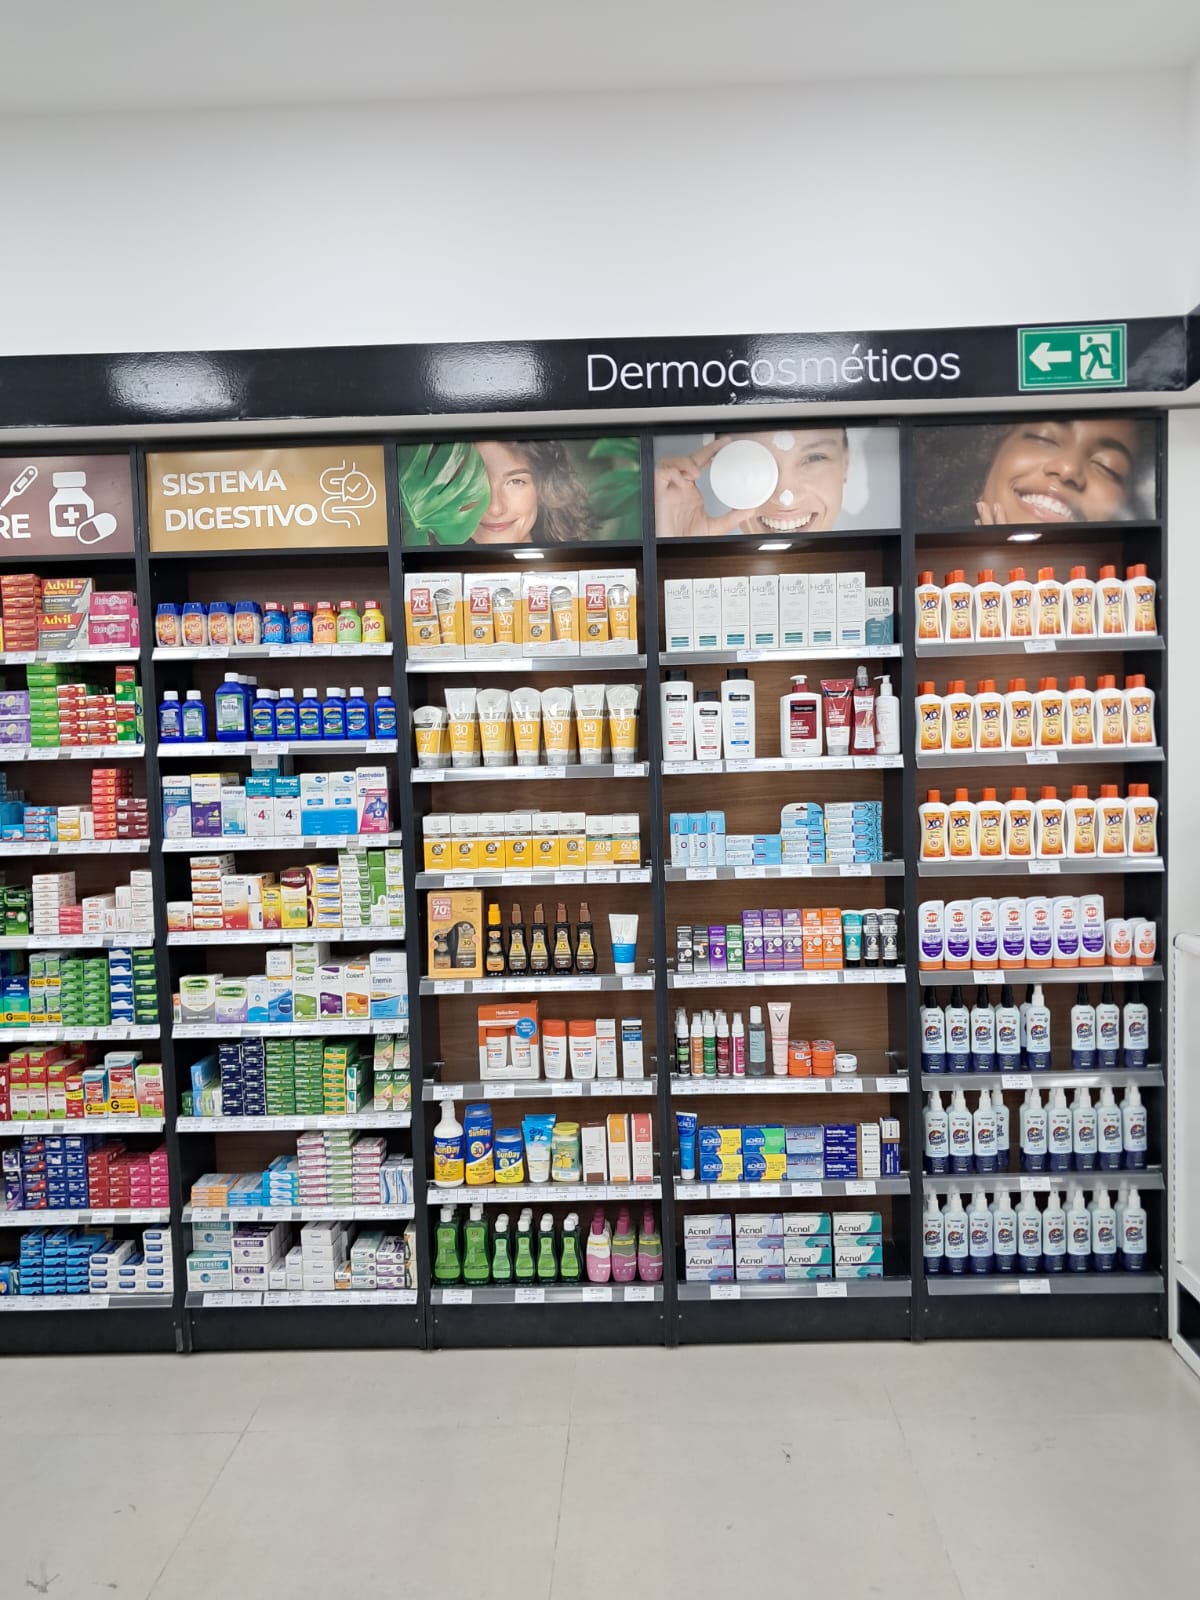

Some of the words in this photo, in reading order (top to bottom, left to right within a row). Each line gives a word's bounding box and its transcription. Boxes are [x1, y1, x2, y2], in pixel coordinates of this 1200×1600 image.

[587, 344, 961, 391] Dermocosméticos
[162, 469, 287, 497] SISTEMA
[164, 503, 318, 532] DIGESTIVO
[45, 581, 74, 590] Advil
[868, 597, 890, 607] URÉIA
[43, 615, 72, 625] Advil
[265, 624, 281, 634] ENO
[292, 624, 308, 634] ENO
[317, 623, 334, 632] ENO
[339, 621, 355, 631] ENO
[364, 622, 380, 632] ENO
[258, 809, 265, 820] 4
[285, 810, 293, 820] 4
[6, 1013, 13, 1021] G
[775, 1013, 785, 1023] V
[85, 1104, 93, 1112] G
[110, 1100, 120, 1110] G
[787, 1225, 810, 1233] Acnol
[838, 1224, 861, 1232] Acnol
[689, 1257, 713, 1265] Acnol
